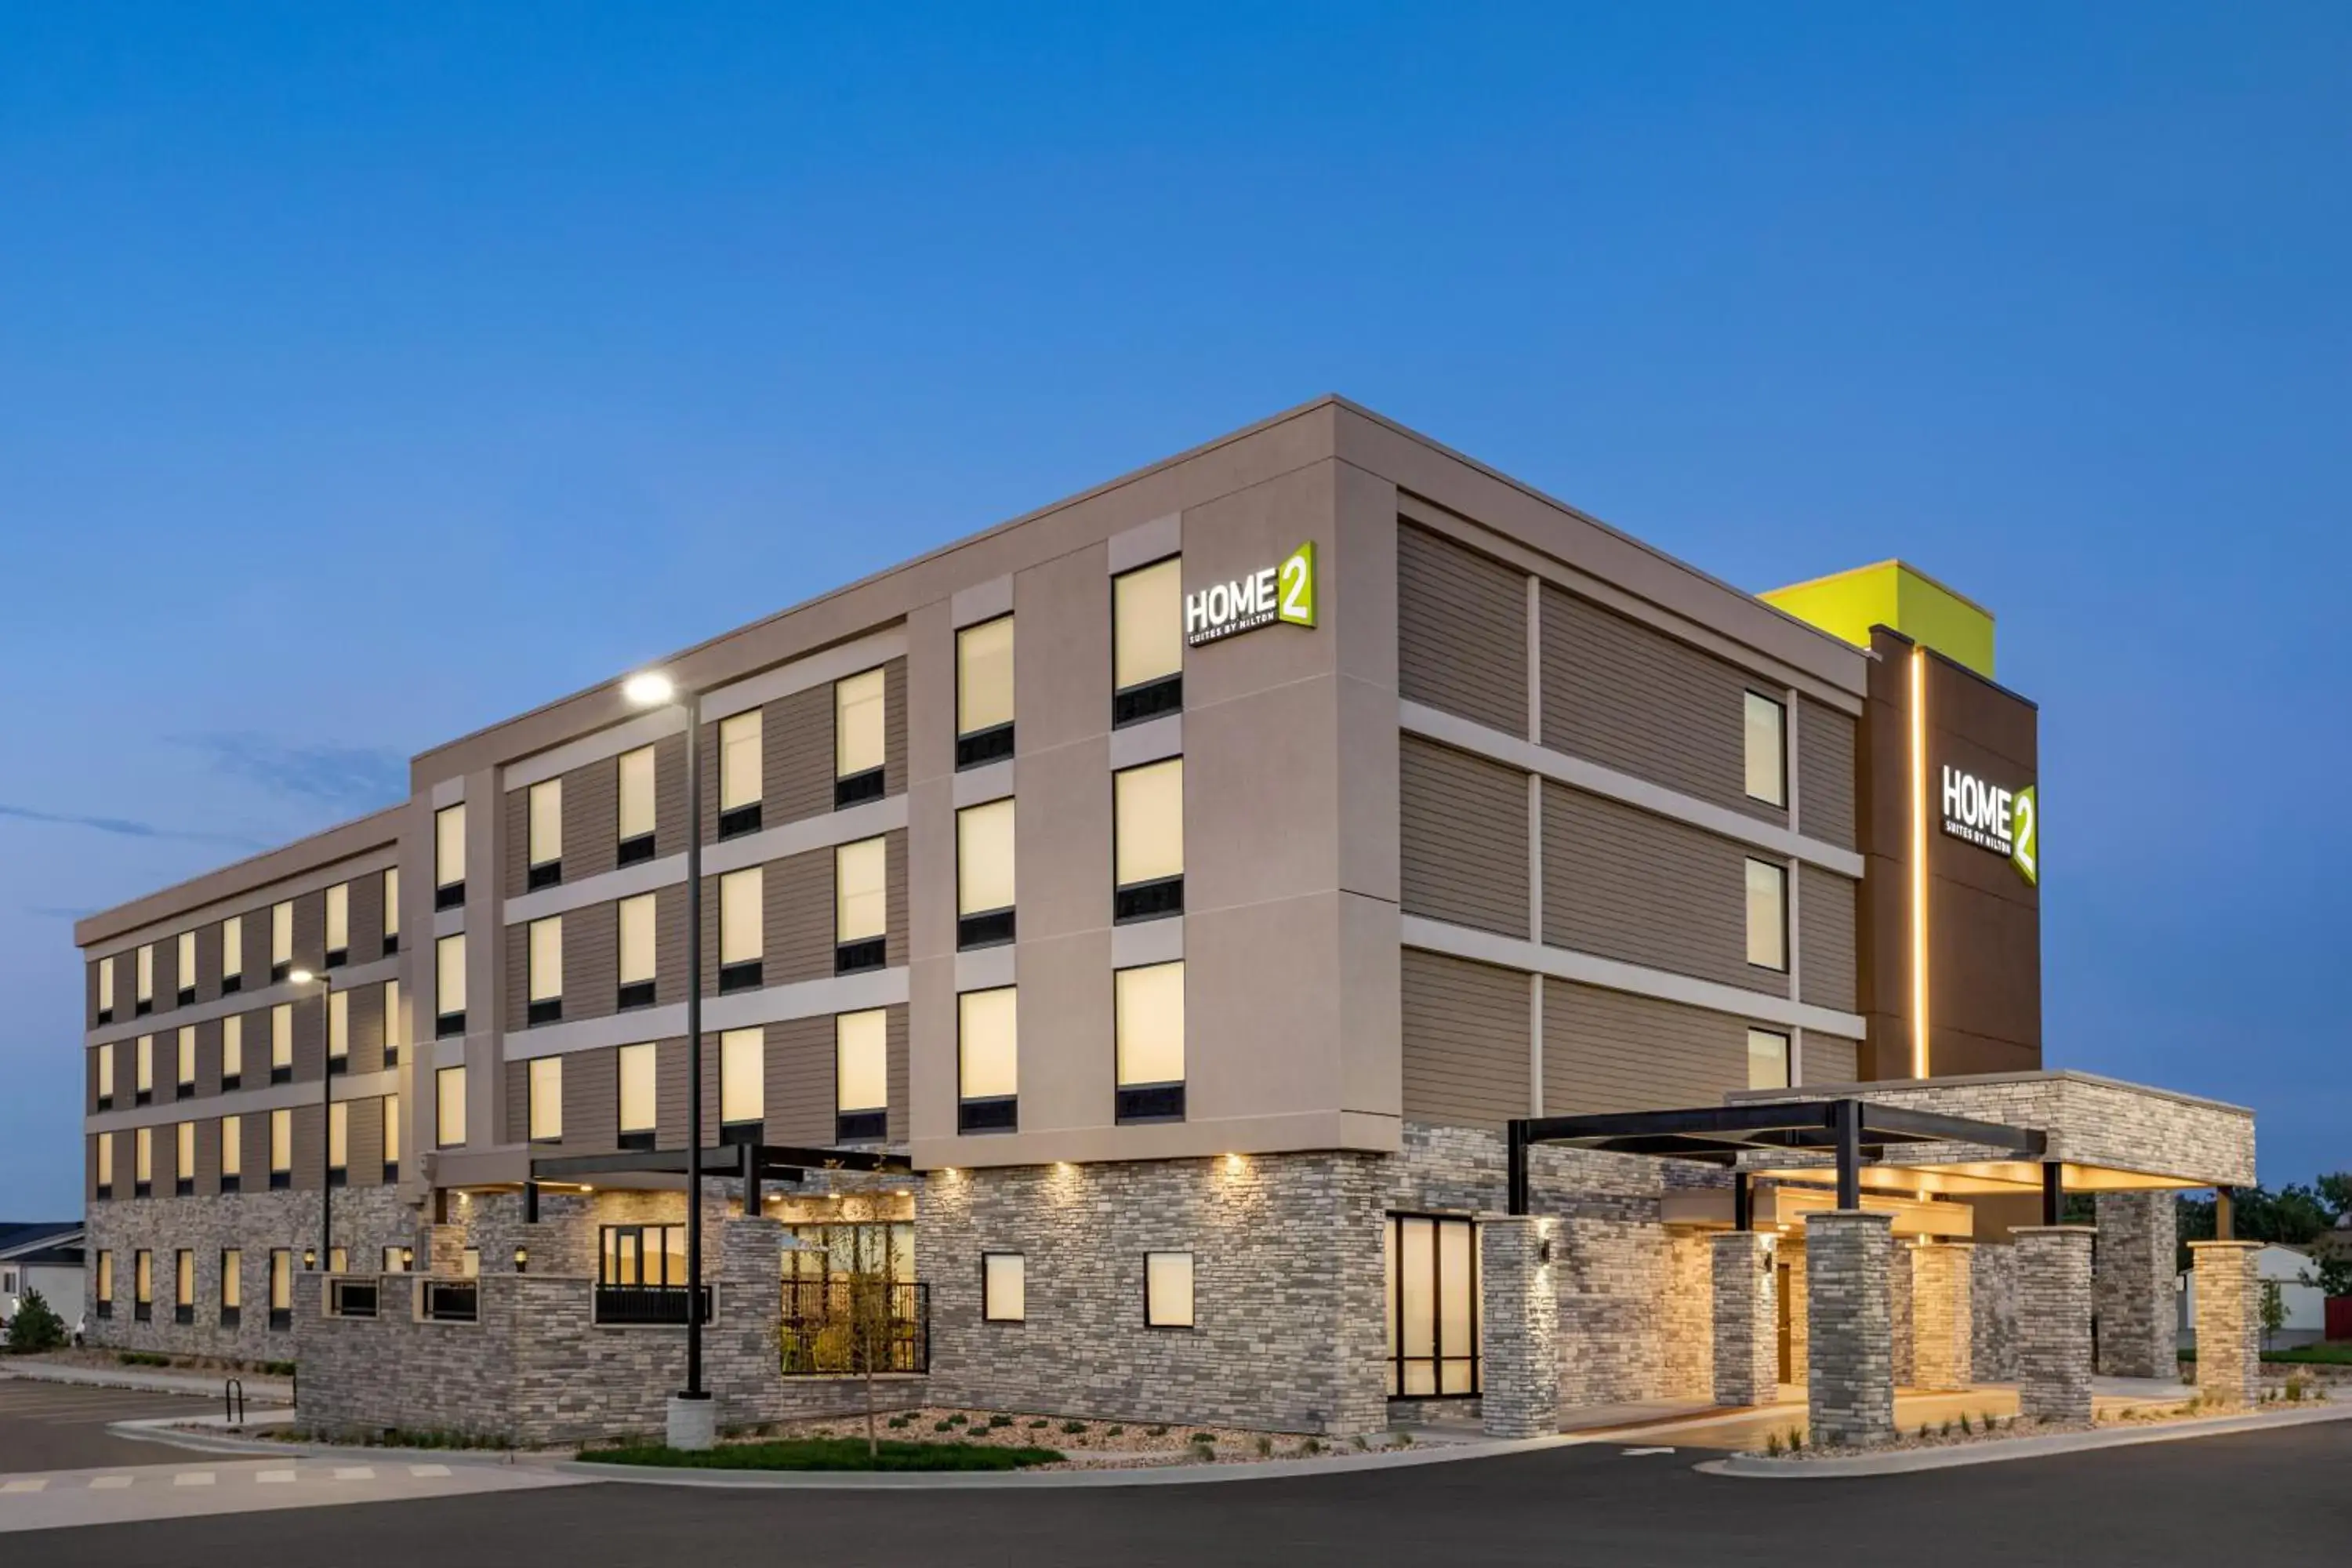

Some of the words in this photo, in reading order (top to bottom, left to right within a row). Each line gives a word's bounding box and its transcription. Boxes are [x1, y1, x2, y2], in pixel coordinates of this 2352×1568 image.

[1186, 567, 1276, 633] HOME
[1283, 556, 1307, 618] 2
[1189, 628, 1222, 644] SUITES
[1225, 623, 1236, 634] BY
[1240, 612, 1274, 628] HILTON
[1944, 764, 2012, 841] HOME
[2016, 797, 2034, 873] 2
[1946, 820, 1972, 840] SUITES
[1974, 830, 1984, 844] BY
[1986, 837, 2011, 855] HILTON
